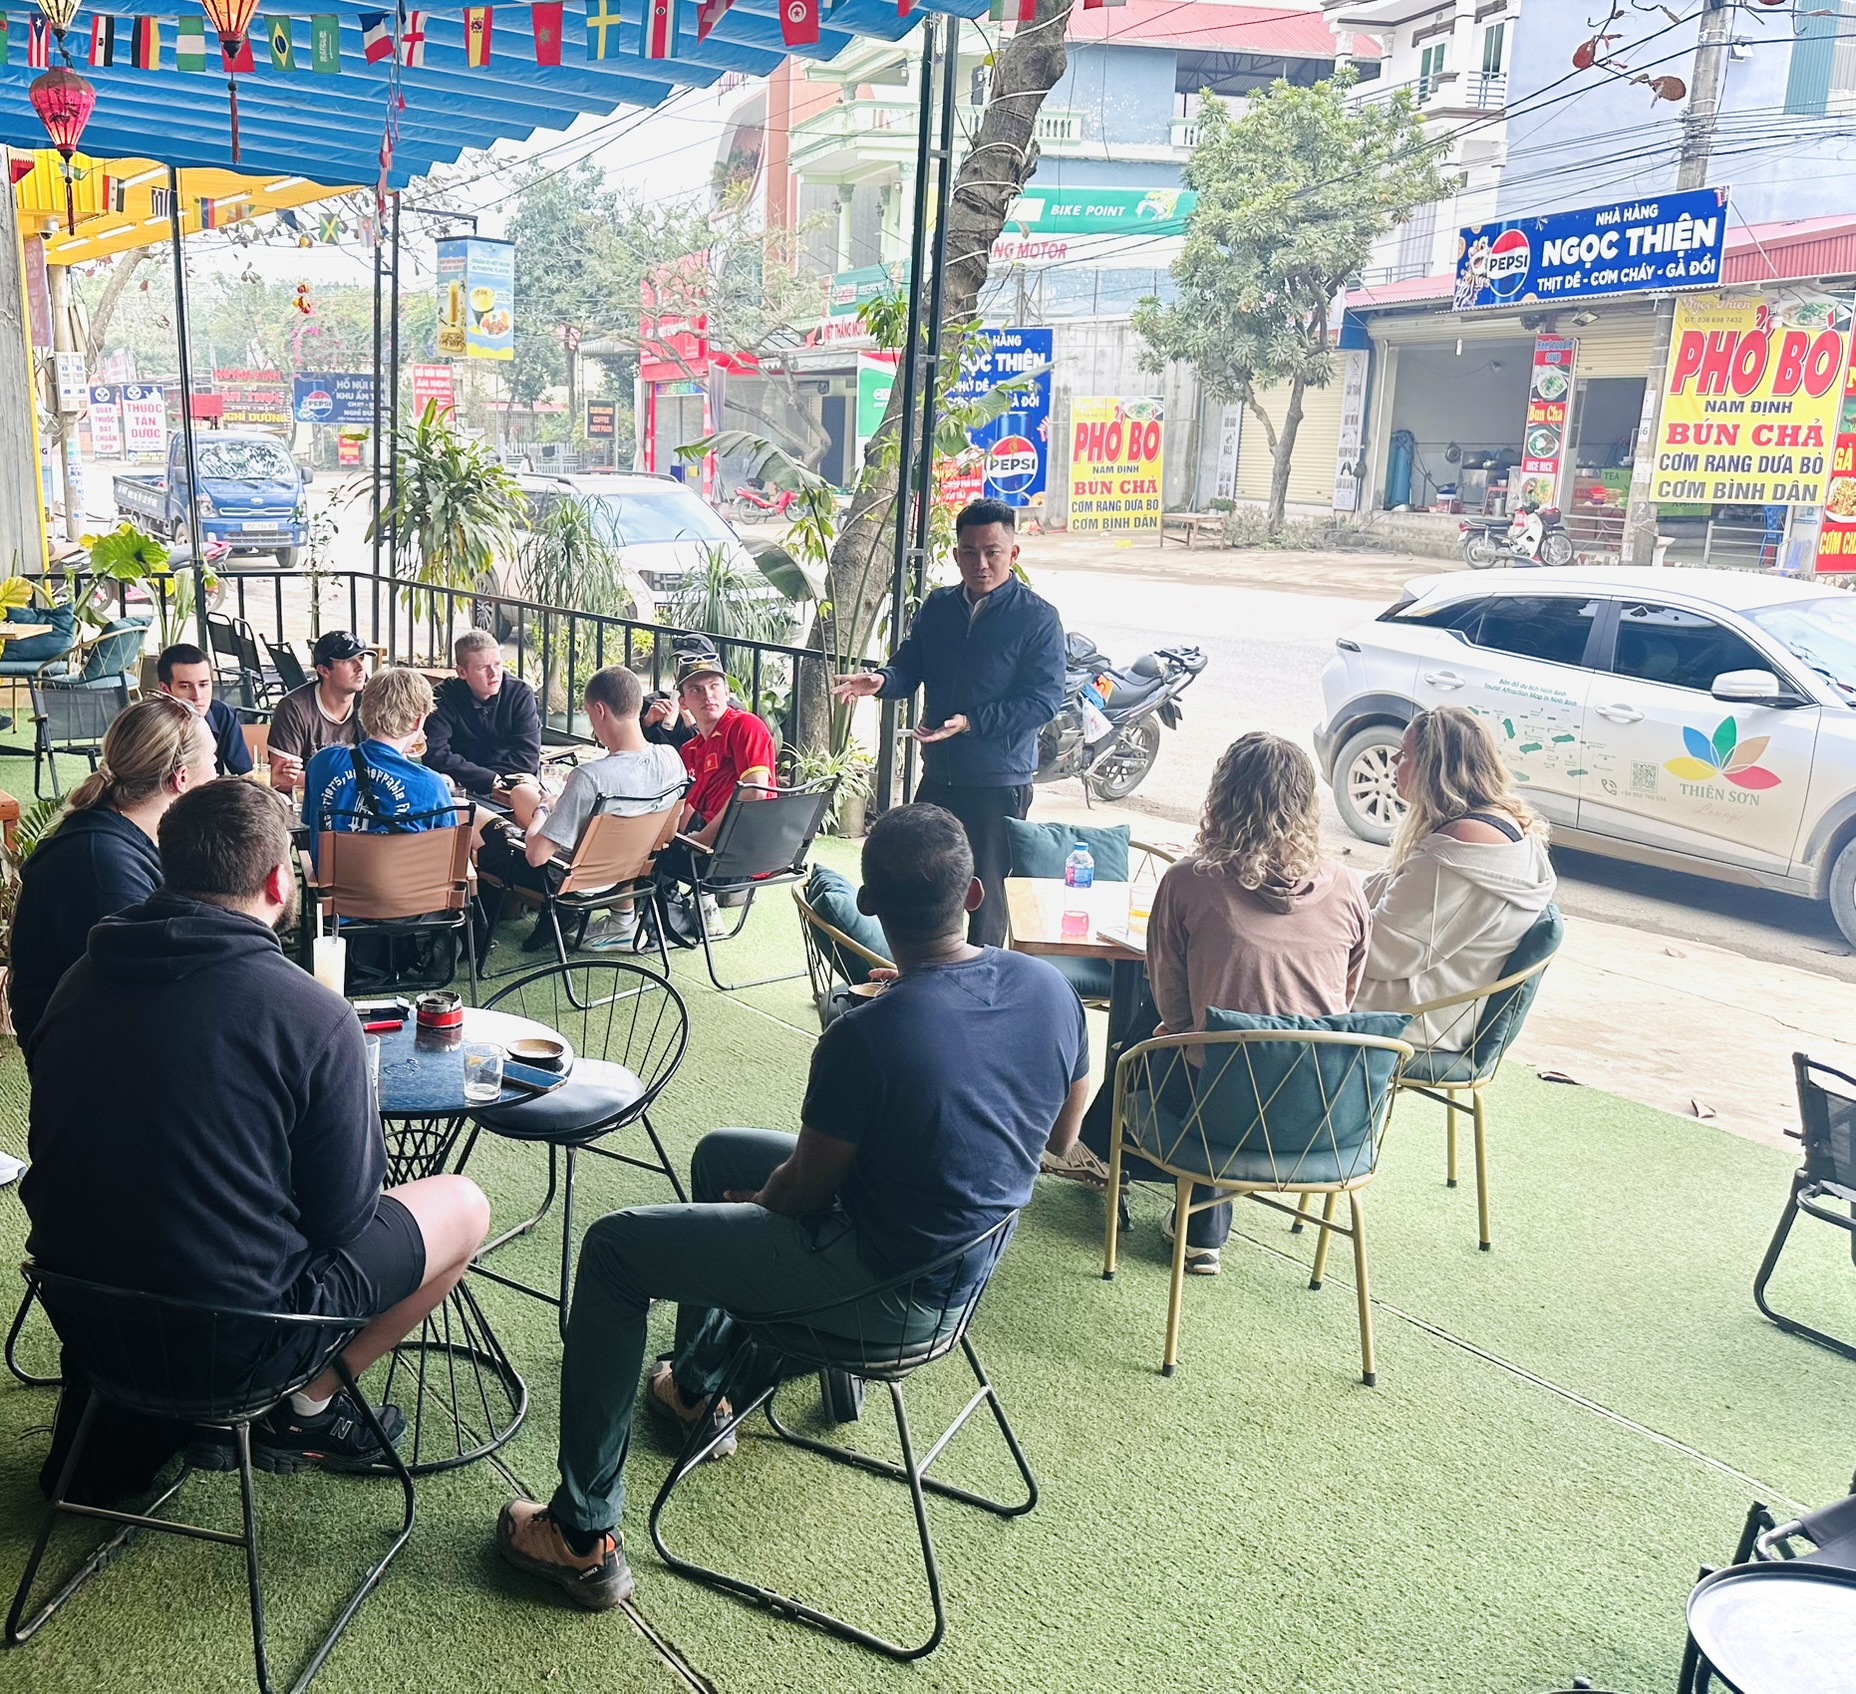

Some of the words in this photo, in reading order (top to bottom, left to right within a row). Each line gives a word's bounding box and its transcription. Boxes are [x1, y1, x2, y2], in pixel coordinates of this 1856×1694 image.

[1050, 204, 1081, 216] BIKE
[1085, 205, 1126, 217] POINT
[1596, 206, 1622, 226] NHÀ
[1623, 203, 1659, 222] HÀNG
[1541, 231, 1620, 268] NGỌC
[1625, 212, 1718, 258] THIỆN
[991, 242, 1014, 258] NG
[1016, 242, 1068, 260] MOTOR
[1489, 254, 1528, 272] PEPSI
[1537, 276, 1565, 294] THỊT
[1564, 273, 1581, 290] DÊ
[1591, 268, 1618, 287] CƠM
[1620, 262, 1656, 284] CHÁY
[1665, 260, 1687, 280] GÀ
[1689, 254, 1716, 277] ĐỒI
[993, 332, 1022, 347] HÀNG
[1669, 305, 1774, 397] PHỞ
[336, 392, 354, 400] KHU
[1529, 405, 1545, 421] Bun
[1546, 405, 1563, 421] Cha
[1704, 400, 1745, 413] NAM
[1750, 401, 1793, 416] ĐỊNH
[1073, 406, 1125, 463] PHỞ
[1665, 417, 1741, 446] BÚN
[1751, 418, 1824, 447] CHẢ
[989, 459, 1035, 471] PEPSI
[1659, 452, 1699, 472] CƠM
[1704, 455, 1753, 474] RANG
[1758, 453, 1793, 474] DƯA
[1800, 451, 1824, 474] BÒ
[1833, 442, 1853, 472] GÀ
[1093, 465, 1114, 474] NAM
[1074, 477, 1113, 496] BÚN
[1119, 475, 1158, 495] CHẢ
[1657, 480, 1706, 499] CƠM
[1712, 479, 1766, 501] BÌNH
[1772, 479, 1818, 502] DÂN
[1072, 500, 1093, 513] CƠM
[1096, 500, 1122, 512] RANG
[1125, 499, 1143, 511] DƯA
[1072, 518, 1098, 531] CƠM
[1102, 515, 1130, 530] BÌNH
[1134, 513, 1158, 528] DÂN
[1818, 529, 1842, 555] CƠM
[1842, 531, 1856, 555] CH
[1502, 687, 1528, 698] Attraction
[1529, 692, 1543, 701] Map
[1679, 783, 1725, 801] THIÊN
[1727, 790, 1761, 806] SƠN
